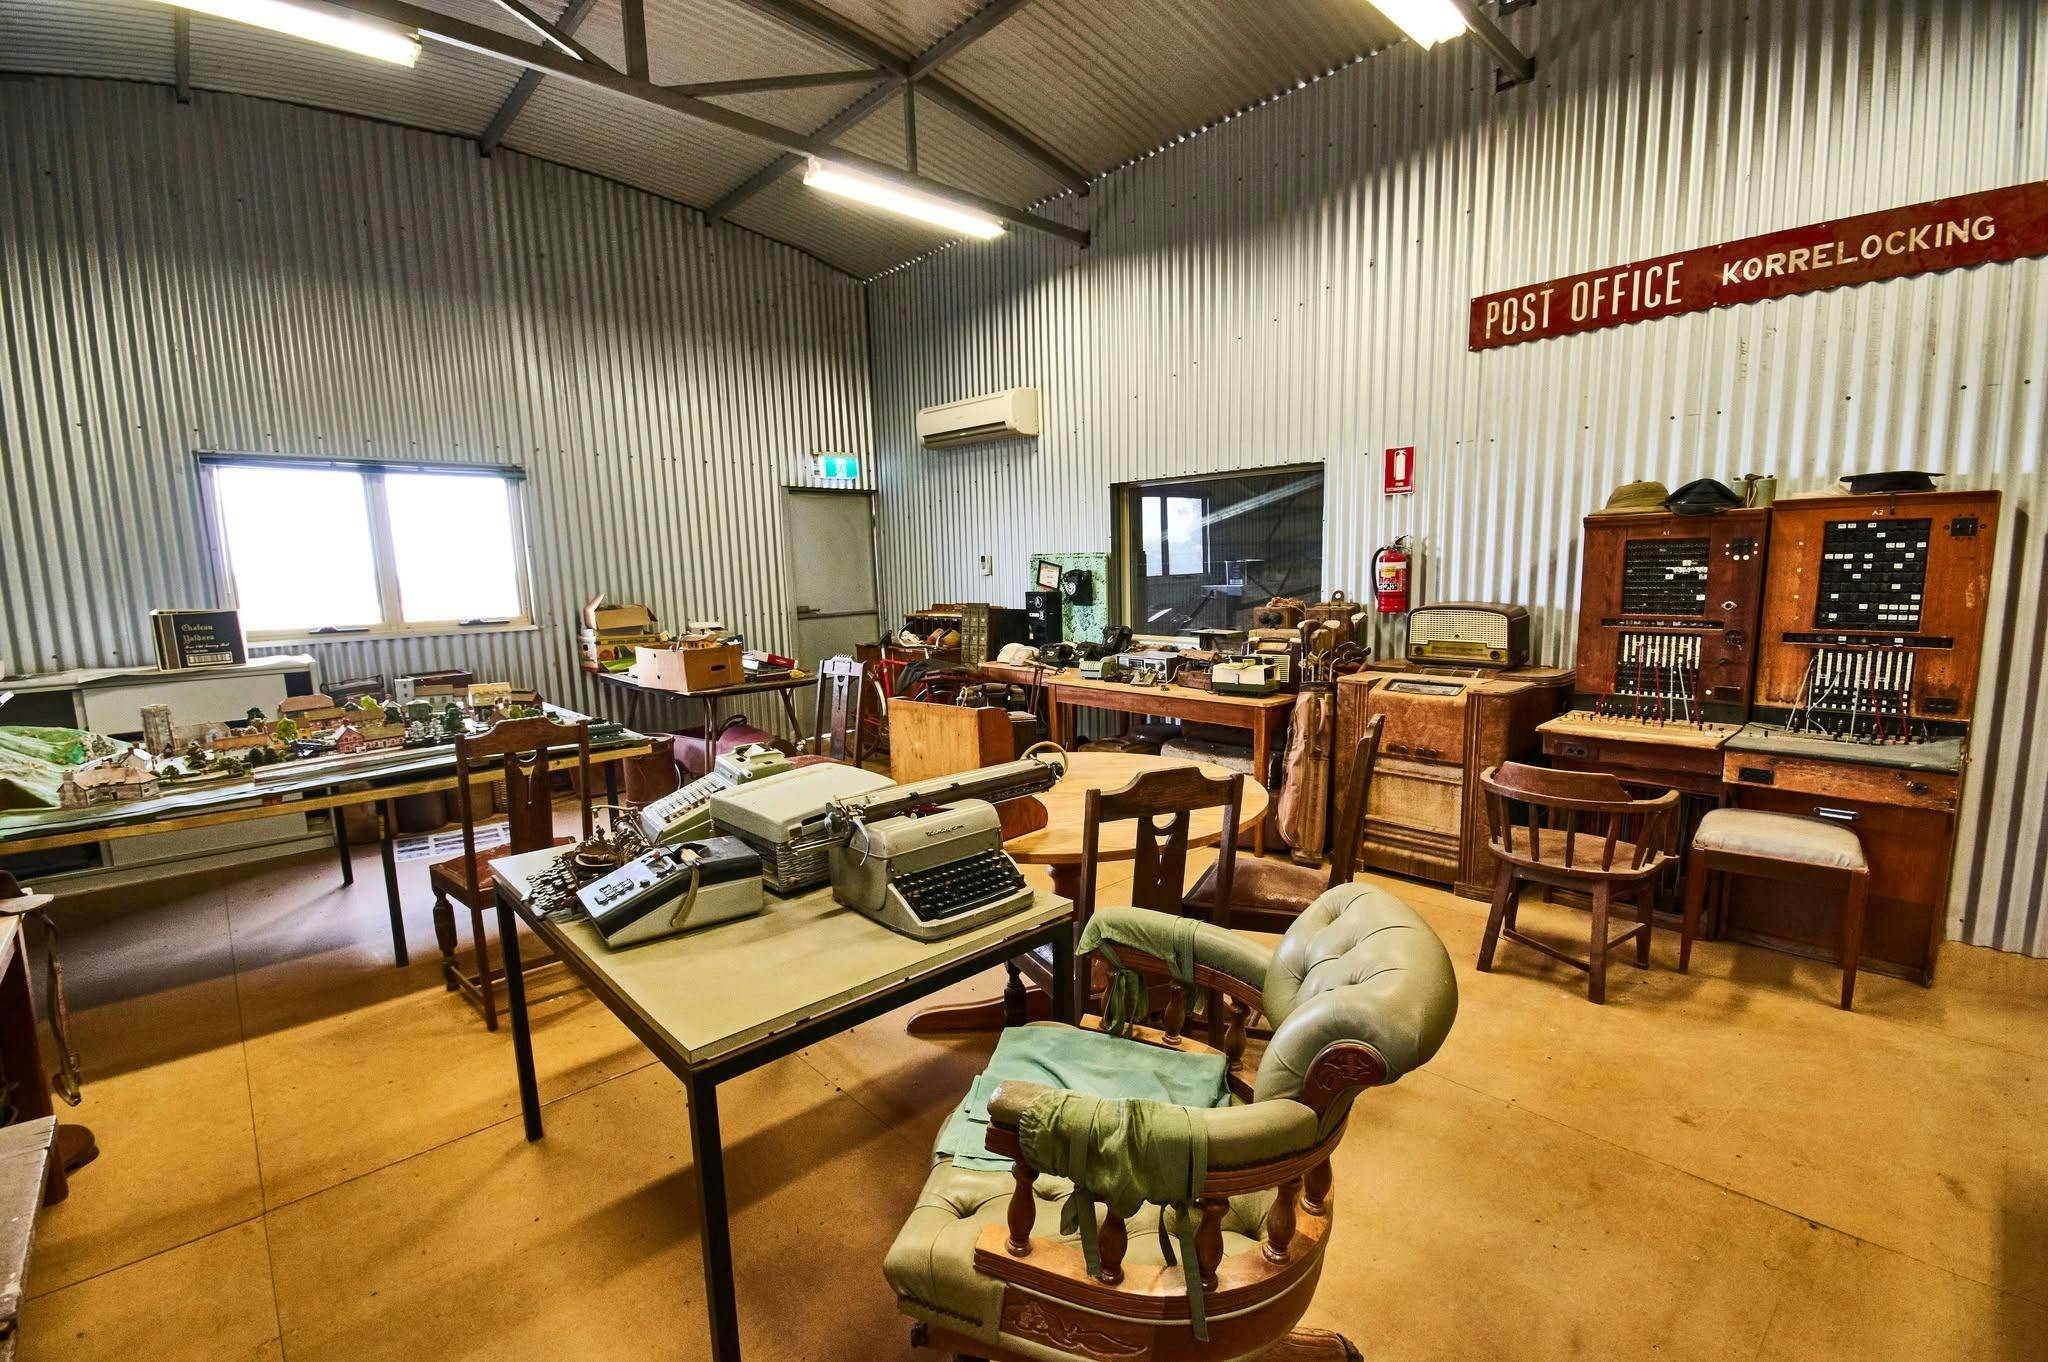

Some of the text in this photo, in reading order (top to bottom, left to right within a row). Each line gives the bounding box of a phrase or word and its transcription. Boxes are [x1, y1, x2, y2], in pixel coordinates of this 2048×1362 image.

[1721, 215, 1995, 286] KORRELOCKING
[1485, 261, 1684, 339] POST OFFICE
